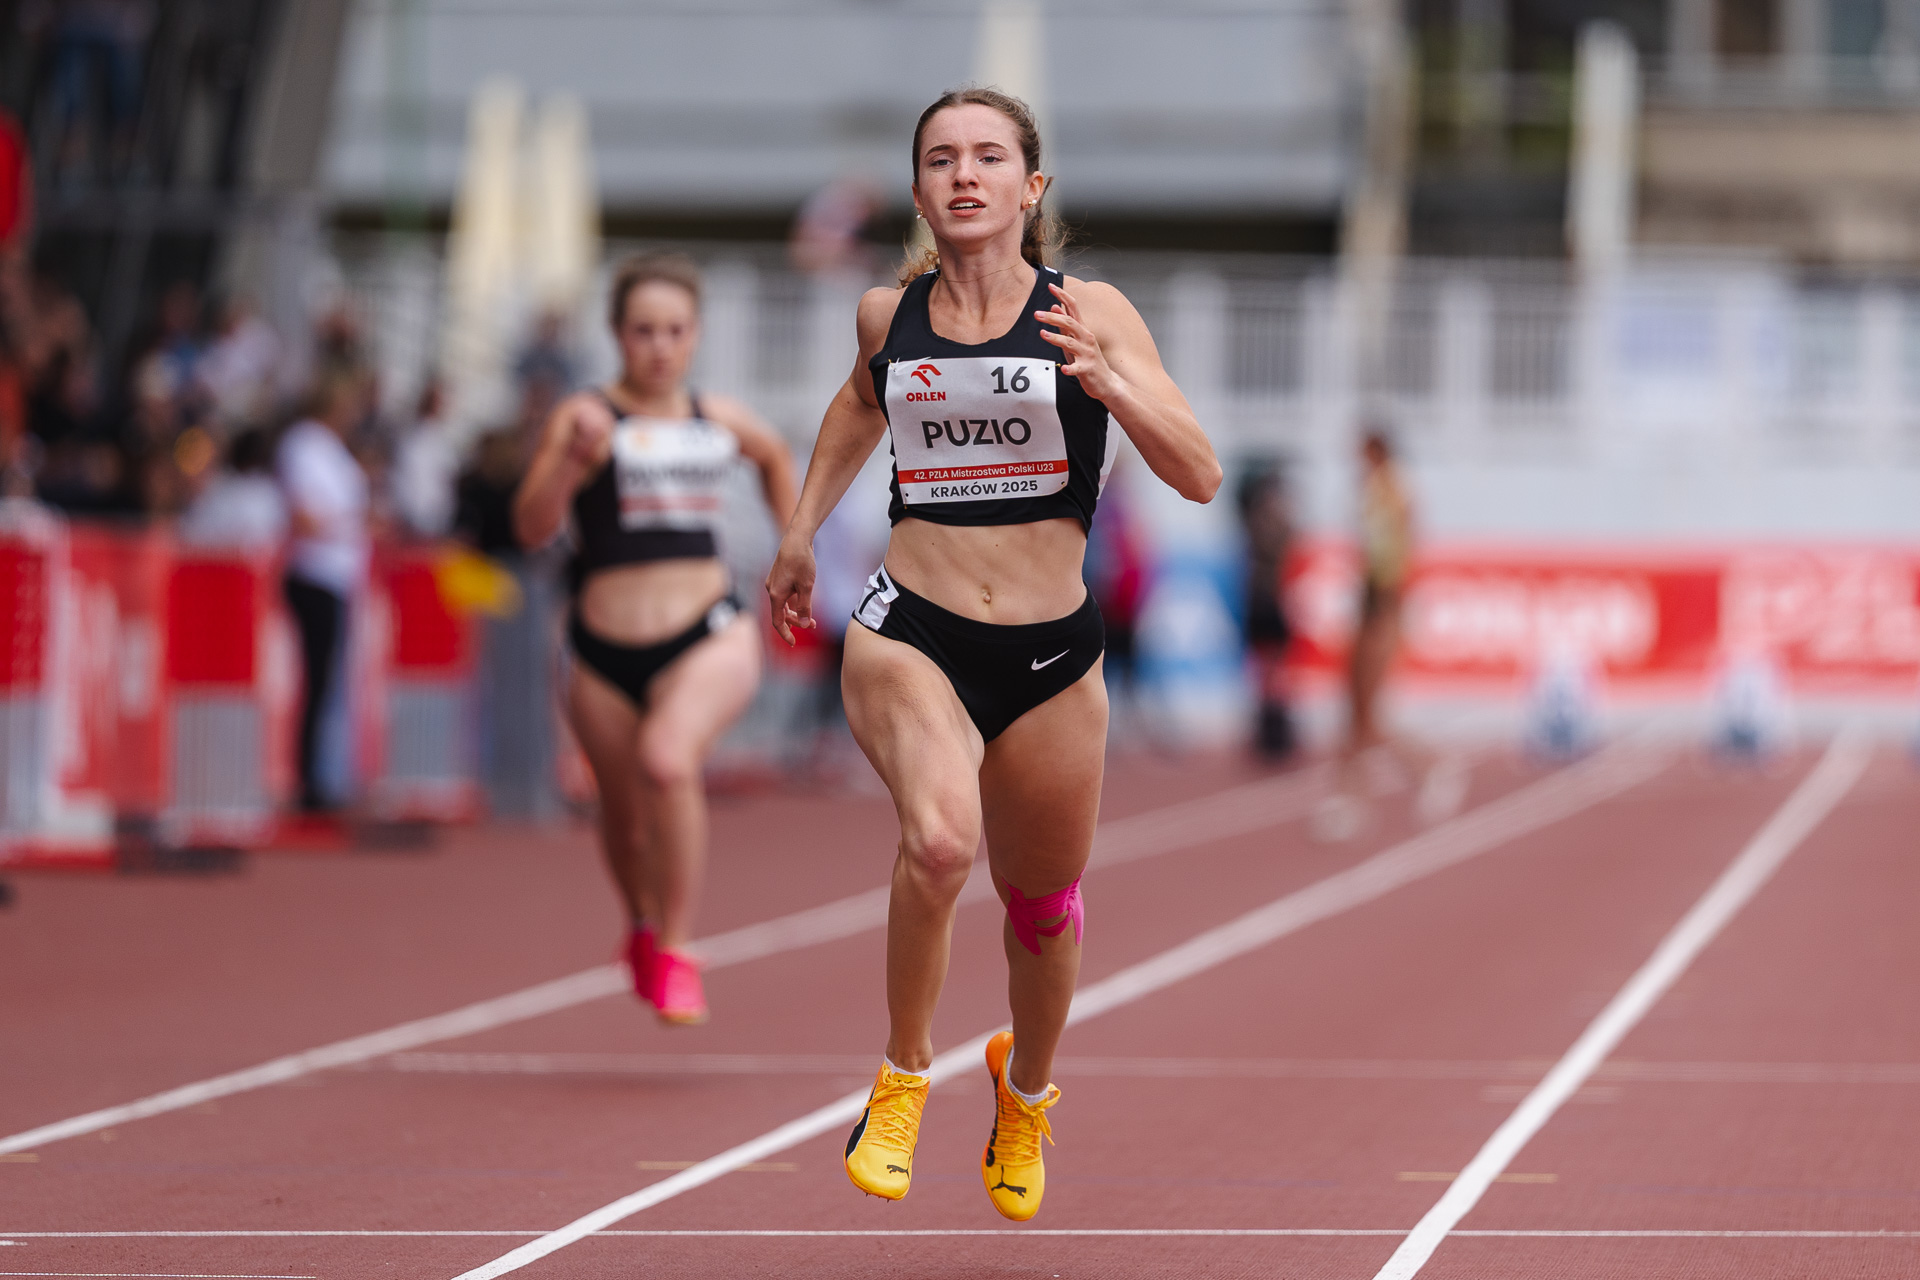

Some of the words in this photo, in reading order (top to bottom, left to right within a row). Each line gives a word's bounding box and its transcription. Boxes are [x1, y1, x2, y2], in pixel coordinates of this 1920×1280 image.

[991, 366, 1030, 394] 16
[906, 391, 946, 402] ORLEN
[921, 417, 1031, 449] PUZIO
[914, 471, 927, 480] 42.
[929, 470, 949, 479] PZLA
[951, 466, 1006, 478] Mistrzostwa
[1008, 463, 1035, 474] Polski
[1037, 463, 1054, 472] U23
[931, 481, 998, 498] KRAKÓW
[1001, 480, 1038, 493] 2025
